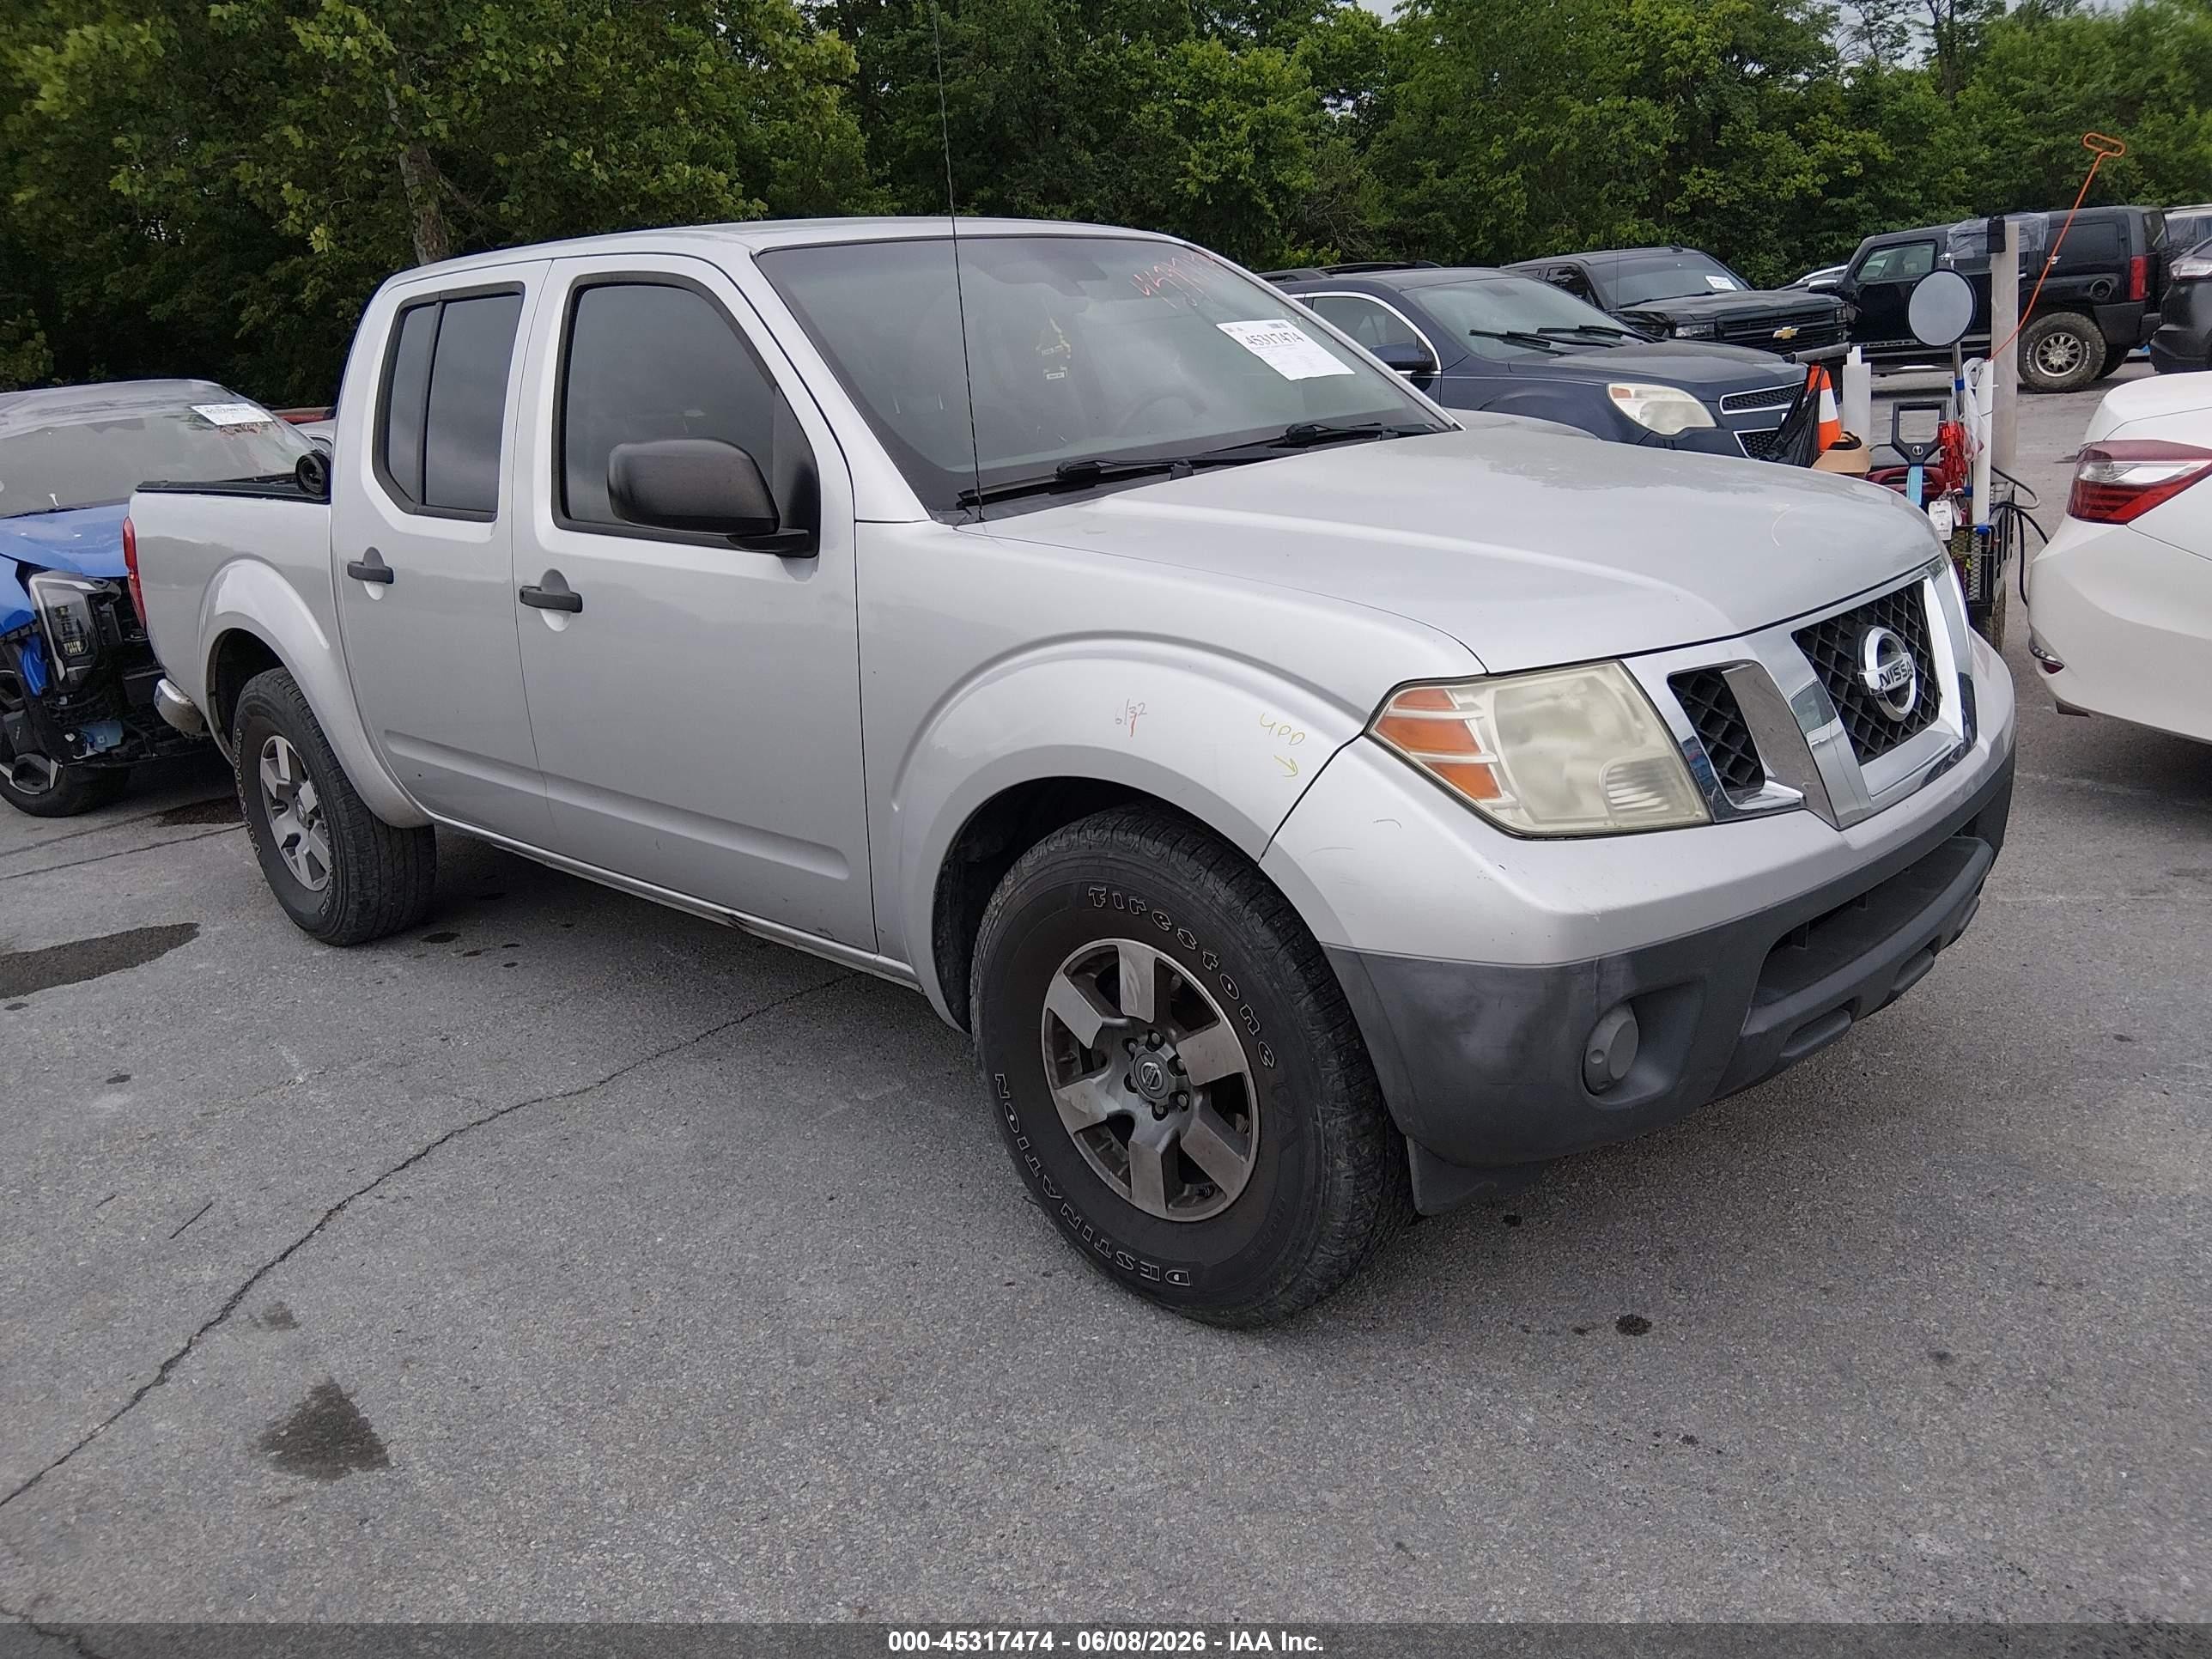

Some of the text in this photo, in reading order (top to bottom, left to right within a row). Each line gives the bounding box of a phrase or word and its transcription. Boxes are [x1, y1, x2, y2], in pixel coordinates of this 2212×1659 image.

[1244, 331, 1305, 346] 45317474
[1088, 886, 1275, 1068] Firestone
[994, 1073, 1191, 1286] DESTINATION
